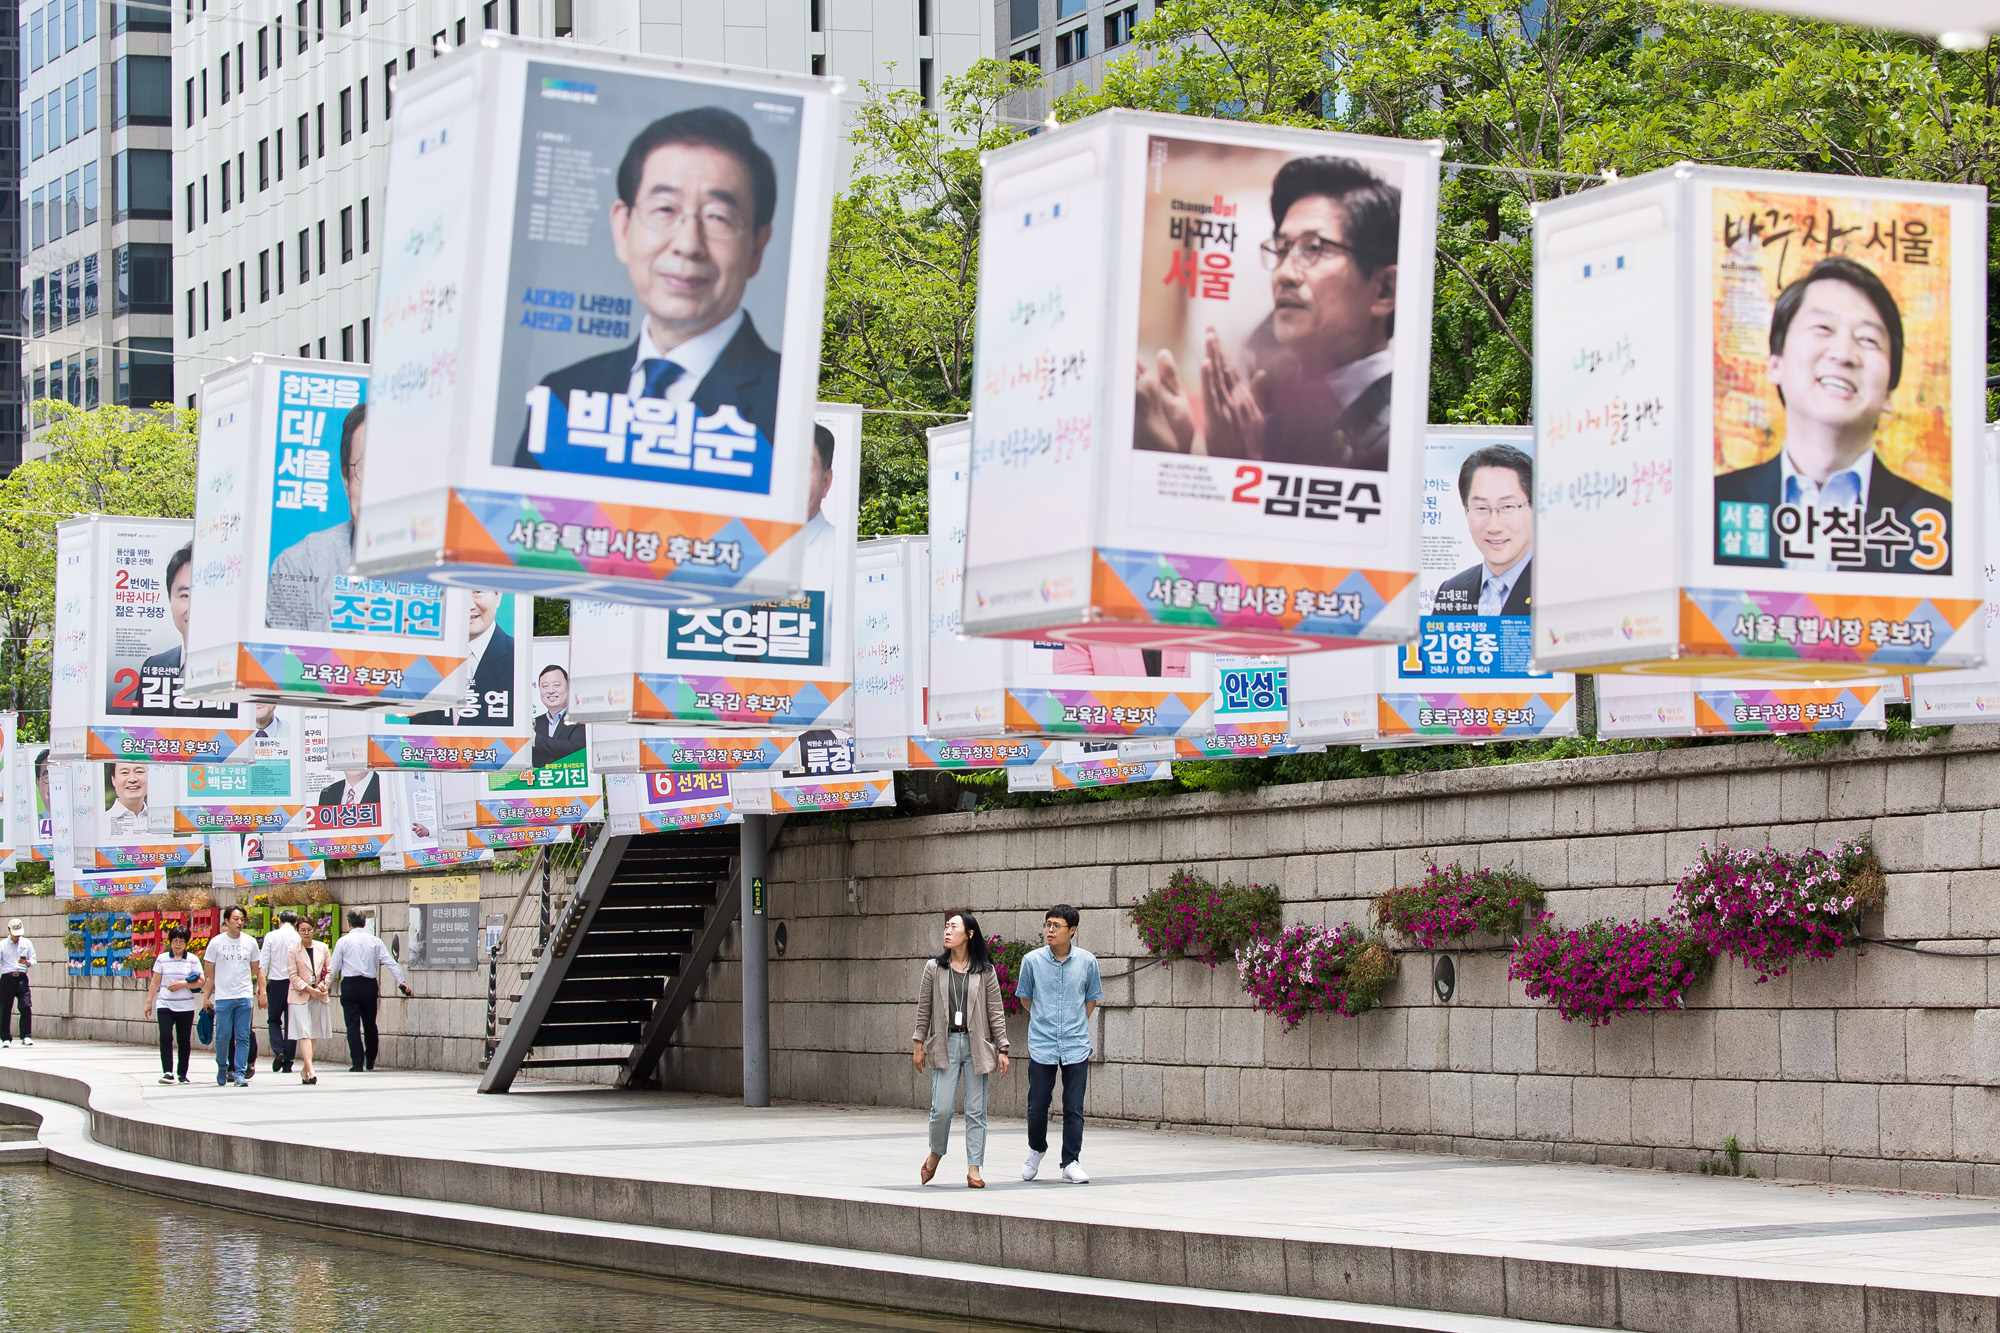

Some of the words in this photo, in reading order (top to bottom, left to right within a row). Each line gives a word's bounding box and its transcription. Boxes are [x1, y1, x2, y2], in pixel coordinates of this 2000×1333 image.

[1170, 216, 1238, 252] 바꾸자
[1725, 208, 1862, 290] 바꾸자
[1866, 220, 1933, 264] 서울
[1163, 250, 1235, 301] 서울
[520, 286, 576, 311] 시대와
[579, 292, 632, 316] 나란히
[519, 310, 573, 333] 시민과
[577, 316, 630, 340] 나란히
[284, 375, 360, 408] 한걸음
[281, 410, 326, 447] 더!
[525, 385, 550, 454] 1
[567, 388, 757, 478] 박원순
[278, 448, 330, 480] 서울
[276, 480, 329, 512] 교육
[1231, 465, 1263, 504] 2
[1264, 474, 1382, 523] 김문수
[1722, 503, 1768, 530] 서울
[508, 520, 661, 563] 서울특별시장
[667, 535, 743, 571] 후보자
[1722, 530, 1768, 556] 살림
[1775, 504, 1911, 565] 안철수
[1911, 509, 1948, 569] 3
[117, 549, 135, 557] 용산을
[137, 549, 150, 557] 위한
[138, 558, 154, 566] 선택!
[115, 569, 160, 591] 2번에는
[355, 577, 441, 598] 서울시교육감
[116, 592, 160, 604] 바꿉시다!
[1149, 577, 1288, 616] 서울특별시장
[1293, 588, 1363, 621] 후보자
[115, 606, 134, 618] 젊은
[137, 606, 165, 618] 구청장
[331, 594, 441, 637] 조희연
[676, 608, 816, 659] 조영달
[1426, 621, 1444, 632] 현재
[1447, 622, 1487, 632] 종로구청장
[1733, 613, 1863, 646] 서울특별시장
[1869, 620, 1933, 648] 후보자
[1423, 633, 1499, 665] 김영종
[143, 667, 150, 675] 더
[301, 665, 350, 684] 교육감
[354, 666, 403, 688] 후보자
[112, 668, 140, 708] 2
[695, 693, 741, 711] 교육감
[746, 695, 792, 713] 후보자
[1734, 704, 1800, 722] 종로구청장
[1805, 702, 1845, 720] 후보자
[1063, 707, 1107, 724] 교육감
[1112, 707, 1156, 725] 후보자
[1420, 709, 1489, 727] 종로구청장
[1492, 708, 1535, 726] 후보자
[121, 738, 180, 753] 용산구청장
[184, 740, 220, 755] 후보자
[1206, 735, 1258, 748] 성동구청장
[1261, 733, 1290, 745] 후보자
[401, 748, 459, 762] 용산구청장
[462, 748, 497, 762] 후보자
[672, 750, 728, 764] 성동구청장
[731, 749, 765, 762] 후보자
[808, 747, 854, 773] 류경
[939, 746, 993, 759] 성동구청장
[997, 745, 1029, 758] 후보자
[190, 766, 206, 790] 3
[208, 775, 247, 790] 백금산
[208, 766, 227, 775] 새로운
[229, 766, 247, 775] 구청장
[519, 771, 535, 786] 4
[538, 769, 585, 787] 문기진
[1078, 768, 1119, 780] 중랑구청장
[1121, 764, 1146, 775] 후보자
[655, 772, 672, 795] 6
[677, 774, 723, 792] 선계선
[797, 793, 840, 805] 중랑구청장
[842, 791, 869, 802] 후보자
[197, 814, 253, 826] 동대문구청장
[254, 814, 283, 825] 후보자
[320, 804, 378, 828] 이성희
[499, 807, 551, 818] 동대문구청장
[554, 805, 581, 817] 후보자
[661, 814, 697, 825] 강북구청장
[699, 811, 721, 822] 후보자
[489, 832, 526, 842] 강북구청장
[527, 830, 549, 840] 후보자
[118, 853, 156, 863] 강북구청장
[157, 852, 182, 862] 후보자
[247, 839, 259, 857] 2
[310, 844, 348, 855] 강북구청장
[349, 843, 373, 852] 후보자
[455, 850, 475, 859] 후보자
[252, 869, 285, 881] 은평구청장
[286, 868, 305, 878] 후보자
[93, 883, 125, 893] 은평구청장
[127, 882, 148, 891] 후보자
